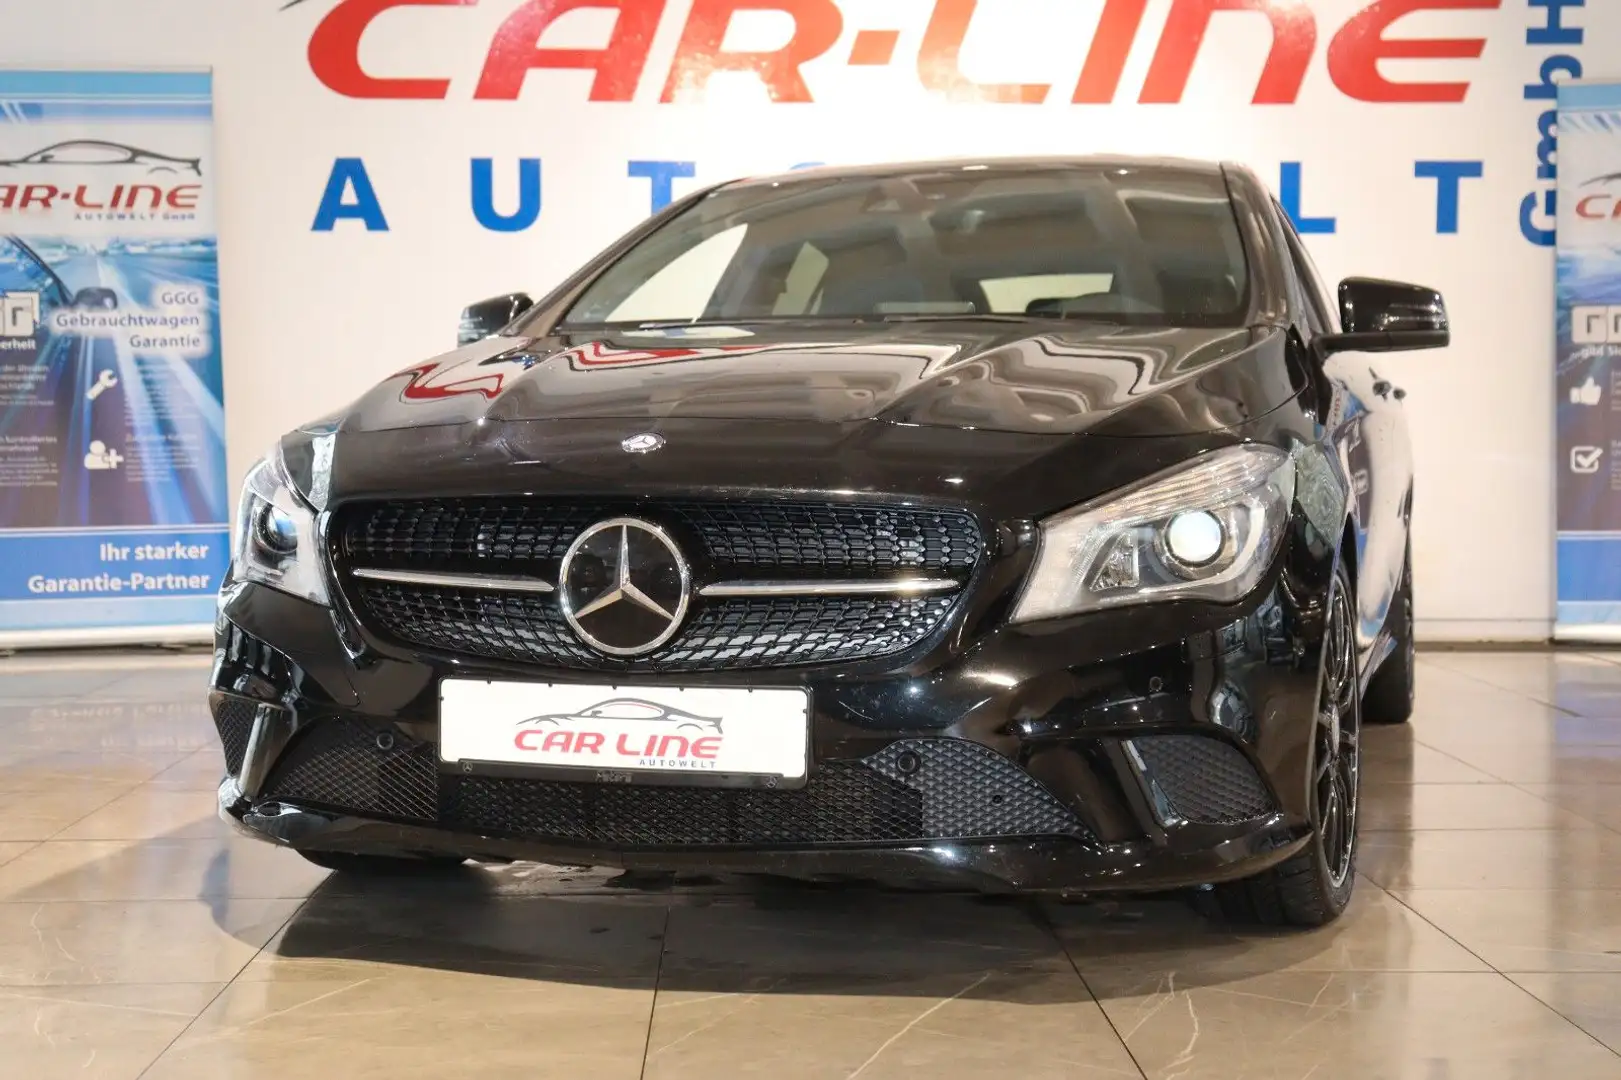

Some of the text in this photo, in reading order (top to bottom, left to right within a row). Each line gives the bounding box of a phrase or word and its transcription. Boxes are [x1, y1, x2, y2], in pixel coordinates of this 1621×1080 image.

[307, 0, 1500, 104] CAR-LINE
[310, 157, 1484, 234] AUTLT
[161, 292, 200, 305] GGG
[56, 312, 200, 329] Gebrauchtwagen
[130, 334, 201, 350] Garantie
[100, 542, 209, 561] Ihr starker
[28, 572, 210, 593] Garantie-Partner
[514, 729, 723, 758] CAR LINE
[639, 759, 716, 768] AUTOWELT
